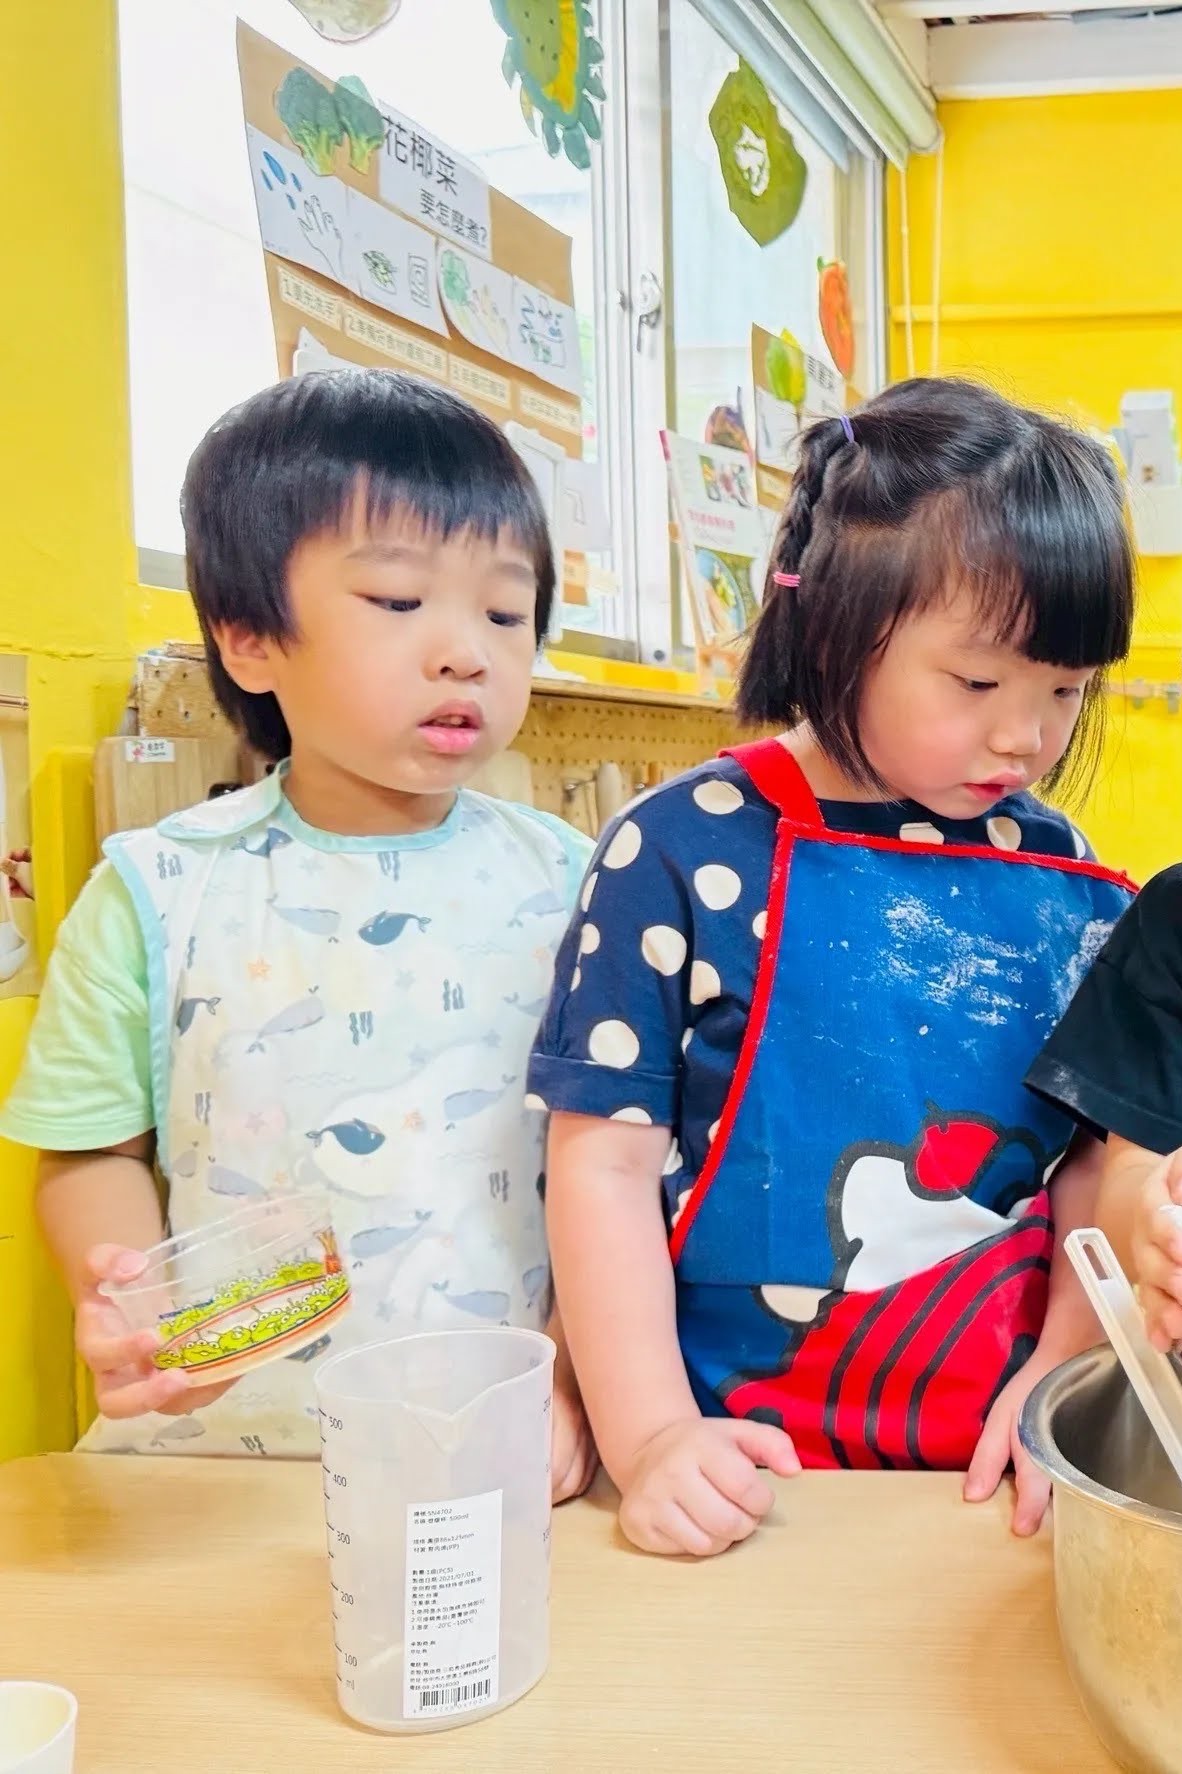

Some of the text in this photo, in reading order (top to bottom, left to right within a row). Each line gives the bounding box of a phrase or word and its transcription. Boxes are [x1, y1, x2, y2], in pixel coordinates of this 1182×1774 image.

[382, 115, 458, 197] 花椰菜
[419, 188, 488, 247] 要怎麼煮?
[329, 1416, 343, 1431] 500
[333, 1474, 347, 1488] 400
[337, 1530, 351, 1545] 300
[341, 1591, 354, 1606] 200
[344, 1652, 358, 1667] 100
